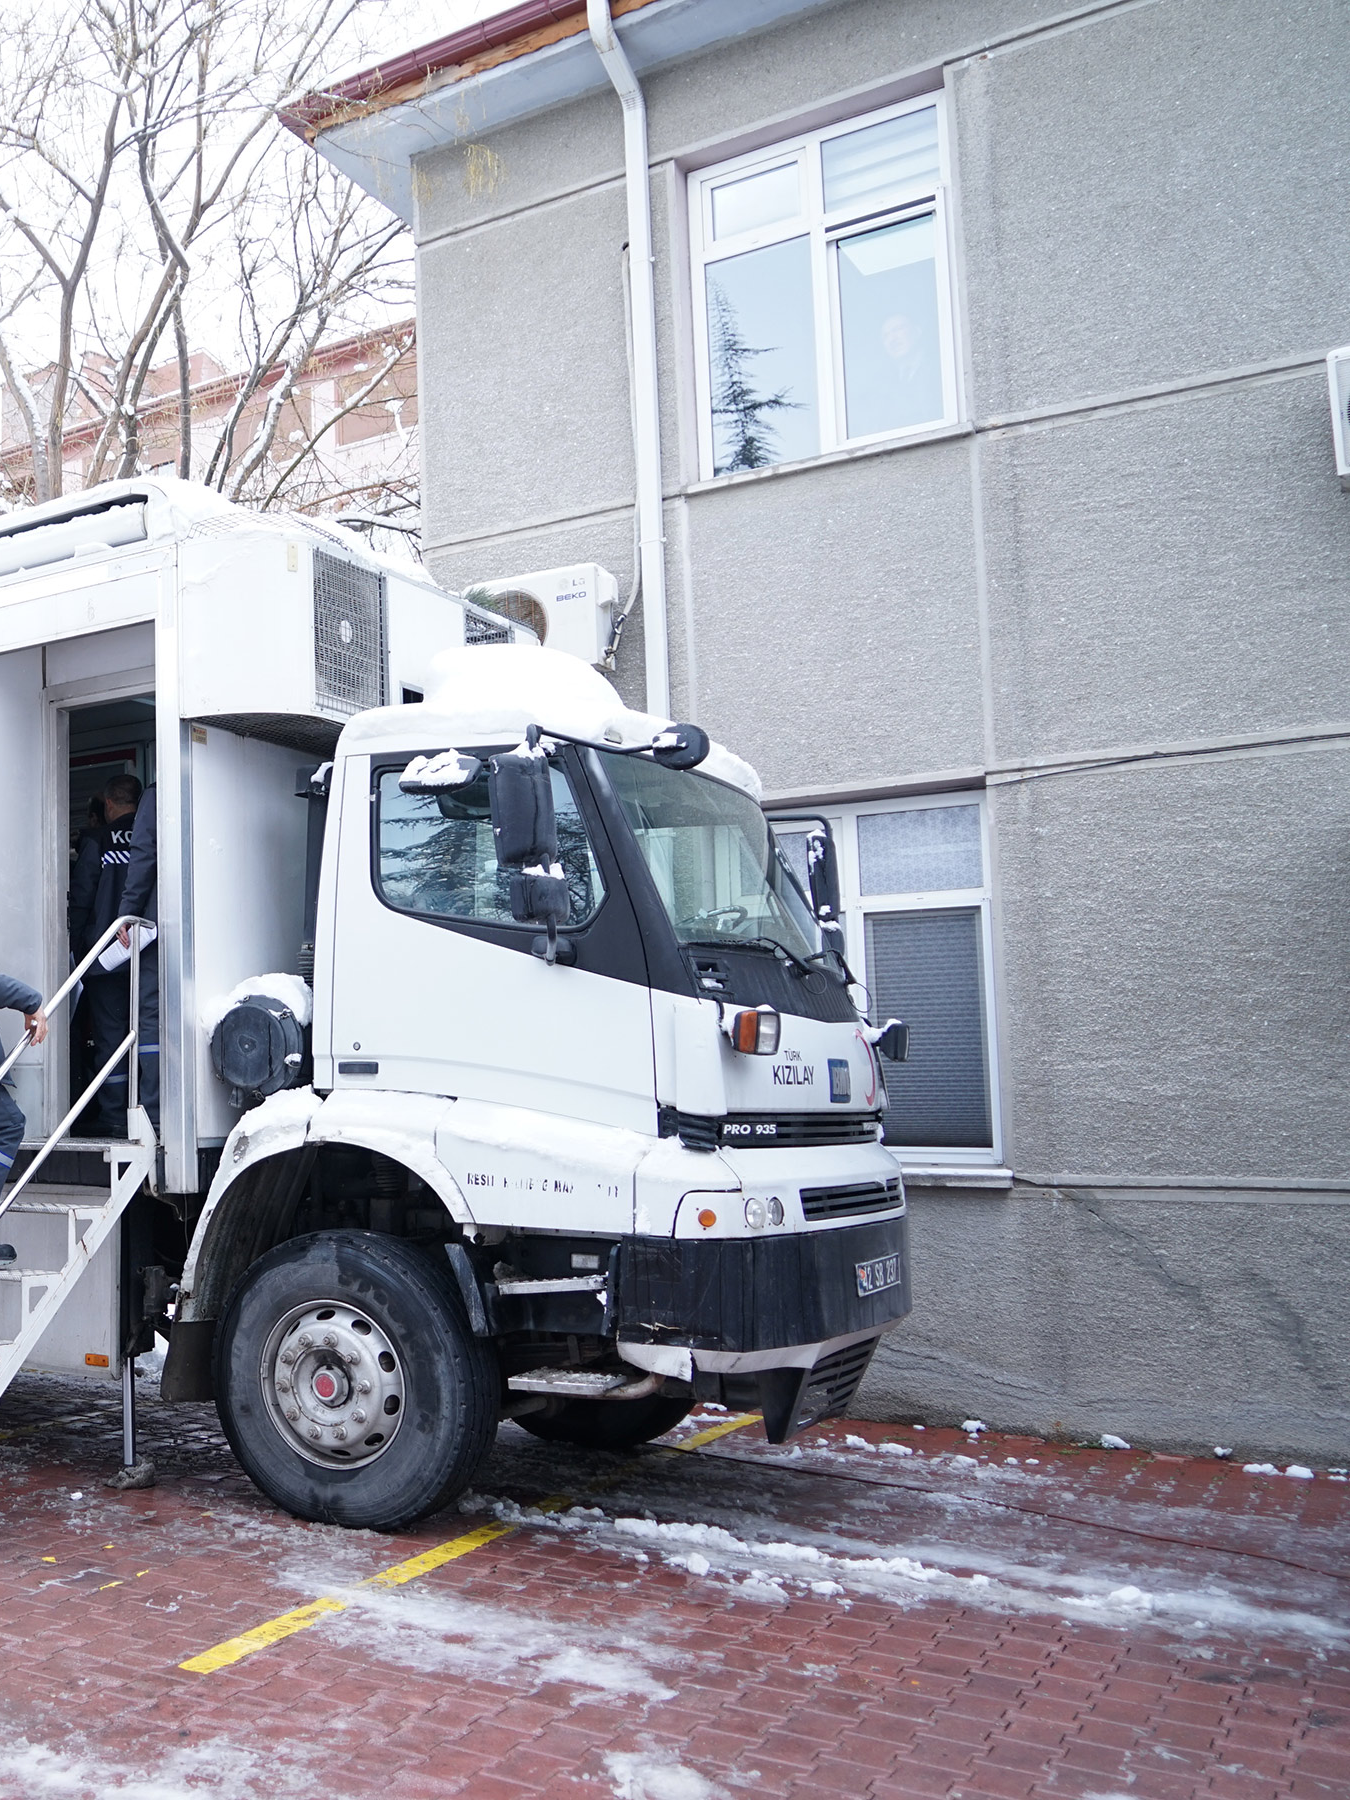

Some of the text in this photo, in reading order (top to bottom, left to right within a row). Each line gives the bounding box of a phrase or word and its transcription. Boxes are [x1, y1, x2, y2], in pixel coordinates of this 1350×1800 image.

[556, 591, 587, 602] BEKO
[110, 830, 133, 844] KO
[784, 1048, 802, 1062] TÜRK
[772, 1064, 815, 1086] KIZILAY
[723, 1123, 777, 1135] PRO 935
[862, 1266, 874, 1291] 42
[874, 1262, 885, 1287] SB
